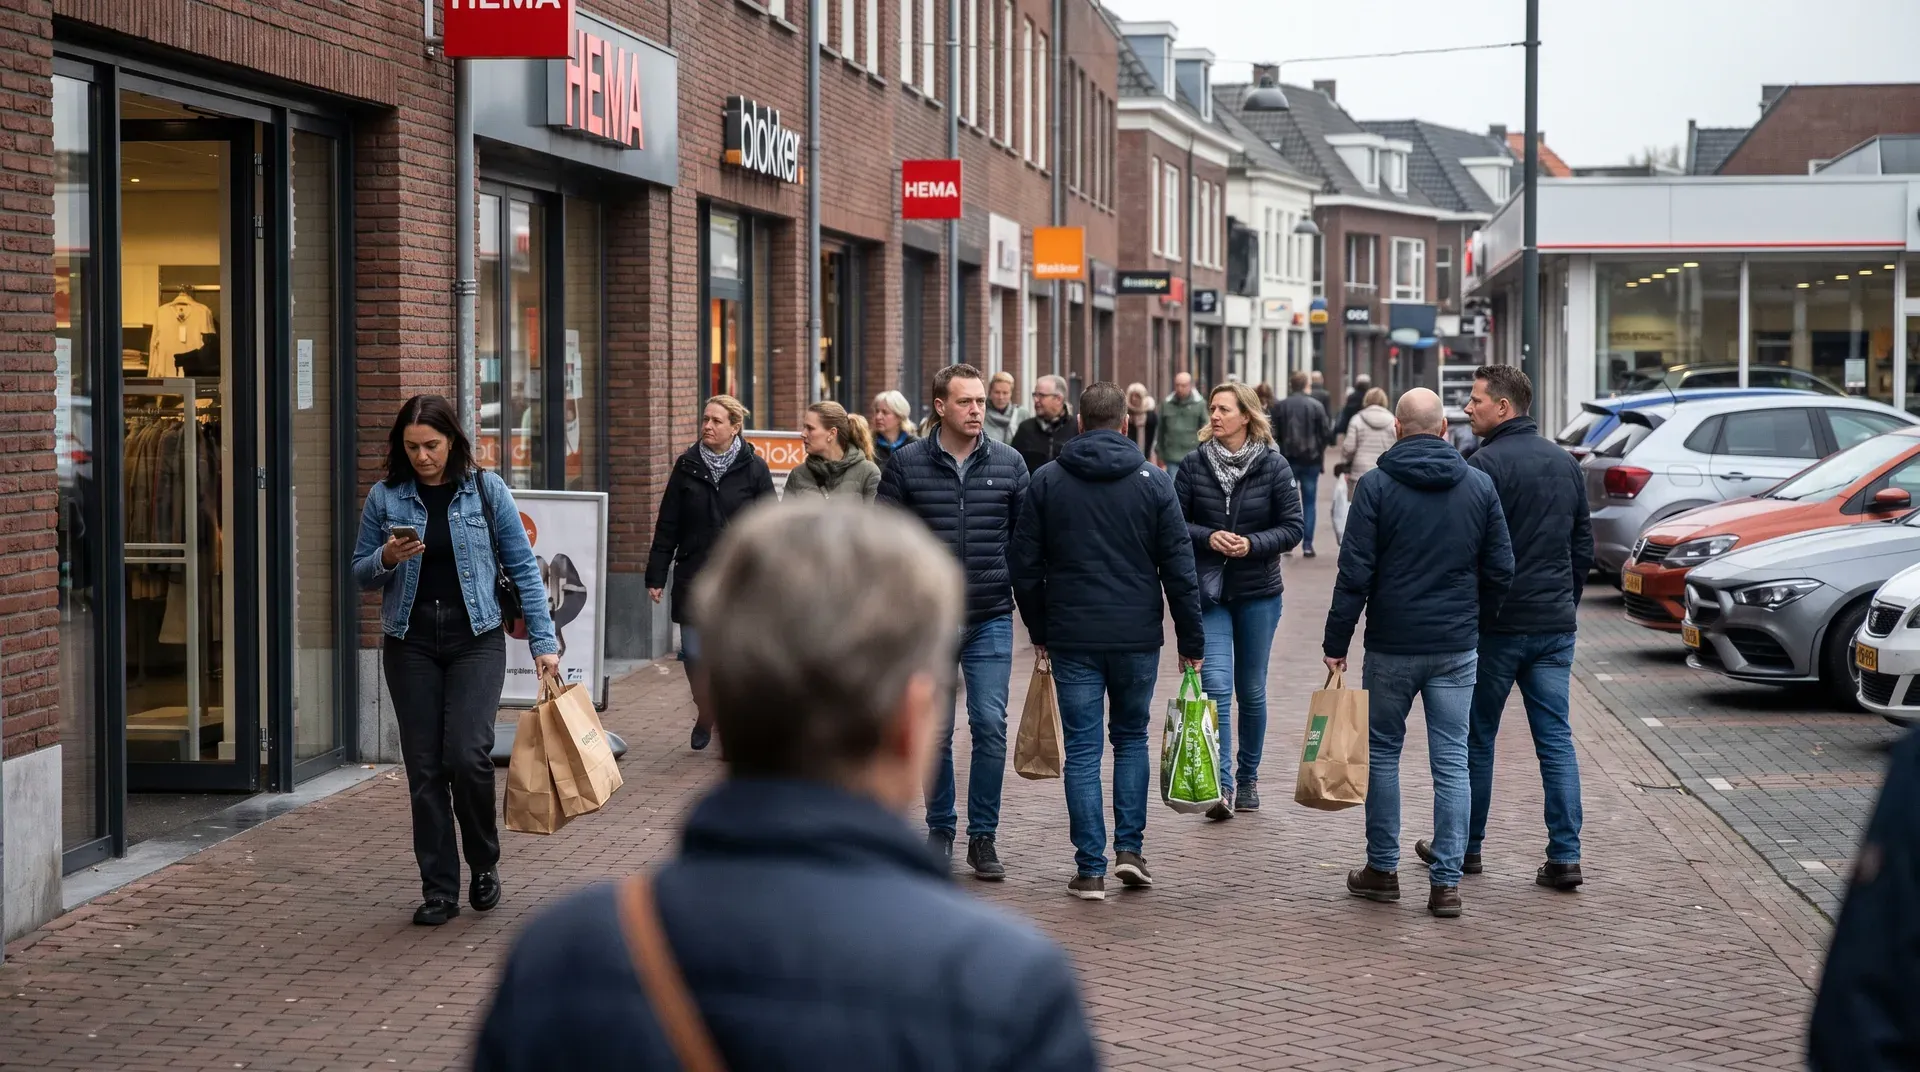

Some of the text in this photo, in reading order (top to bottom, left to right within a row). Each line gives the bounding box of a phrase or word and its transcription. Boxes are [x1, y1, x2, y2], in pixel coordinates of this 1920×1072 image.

[566, 29, 644, 150] HEMA
[740, 94, 800, 184] blokker
[905, 181, 958, 198] HEMA
